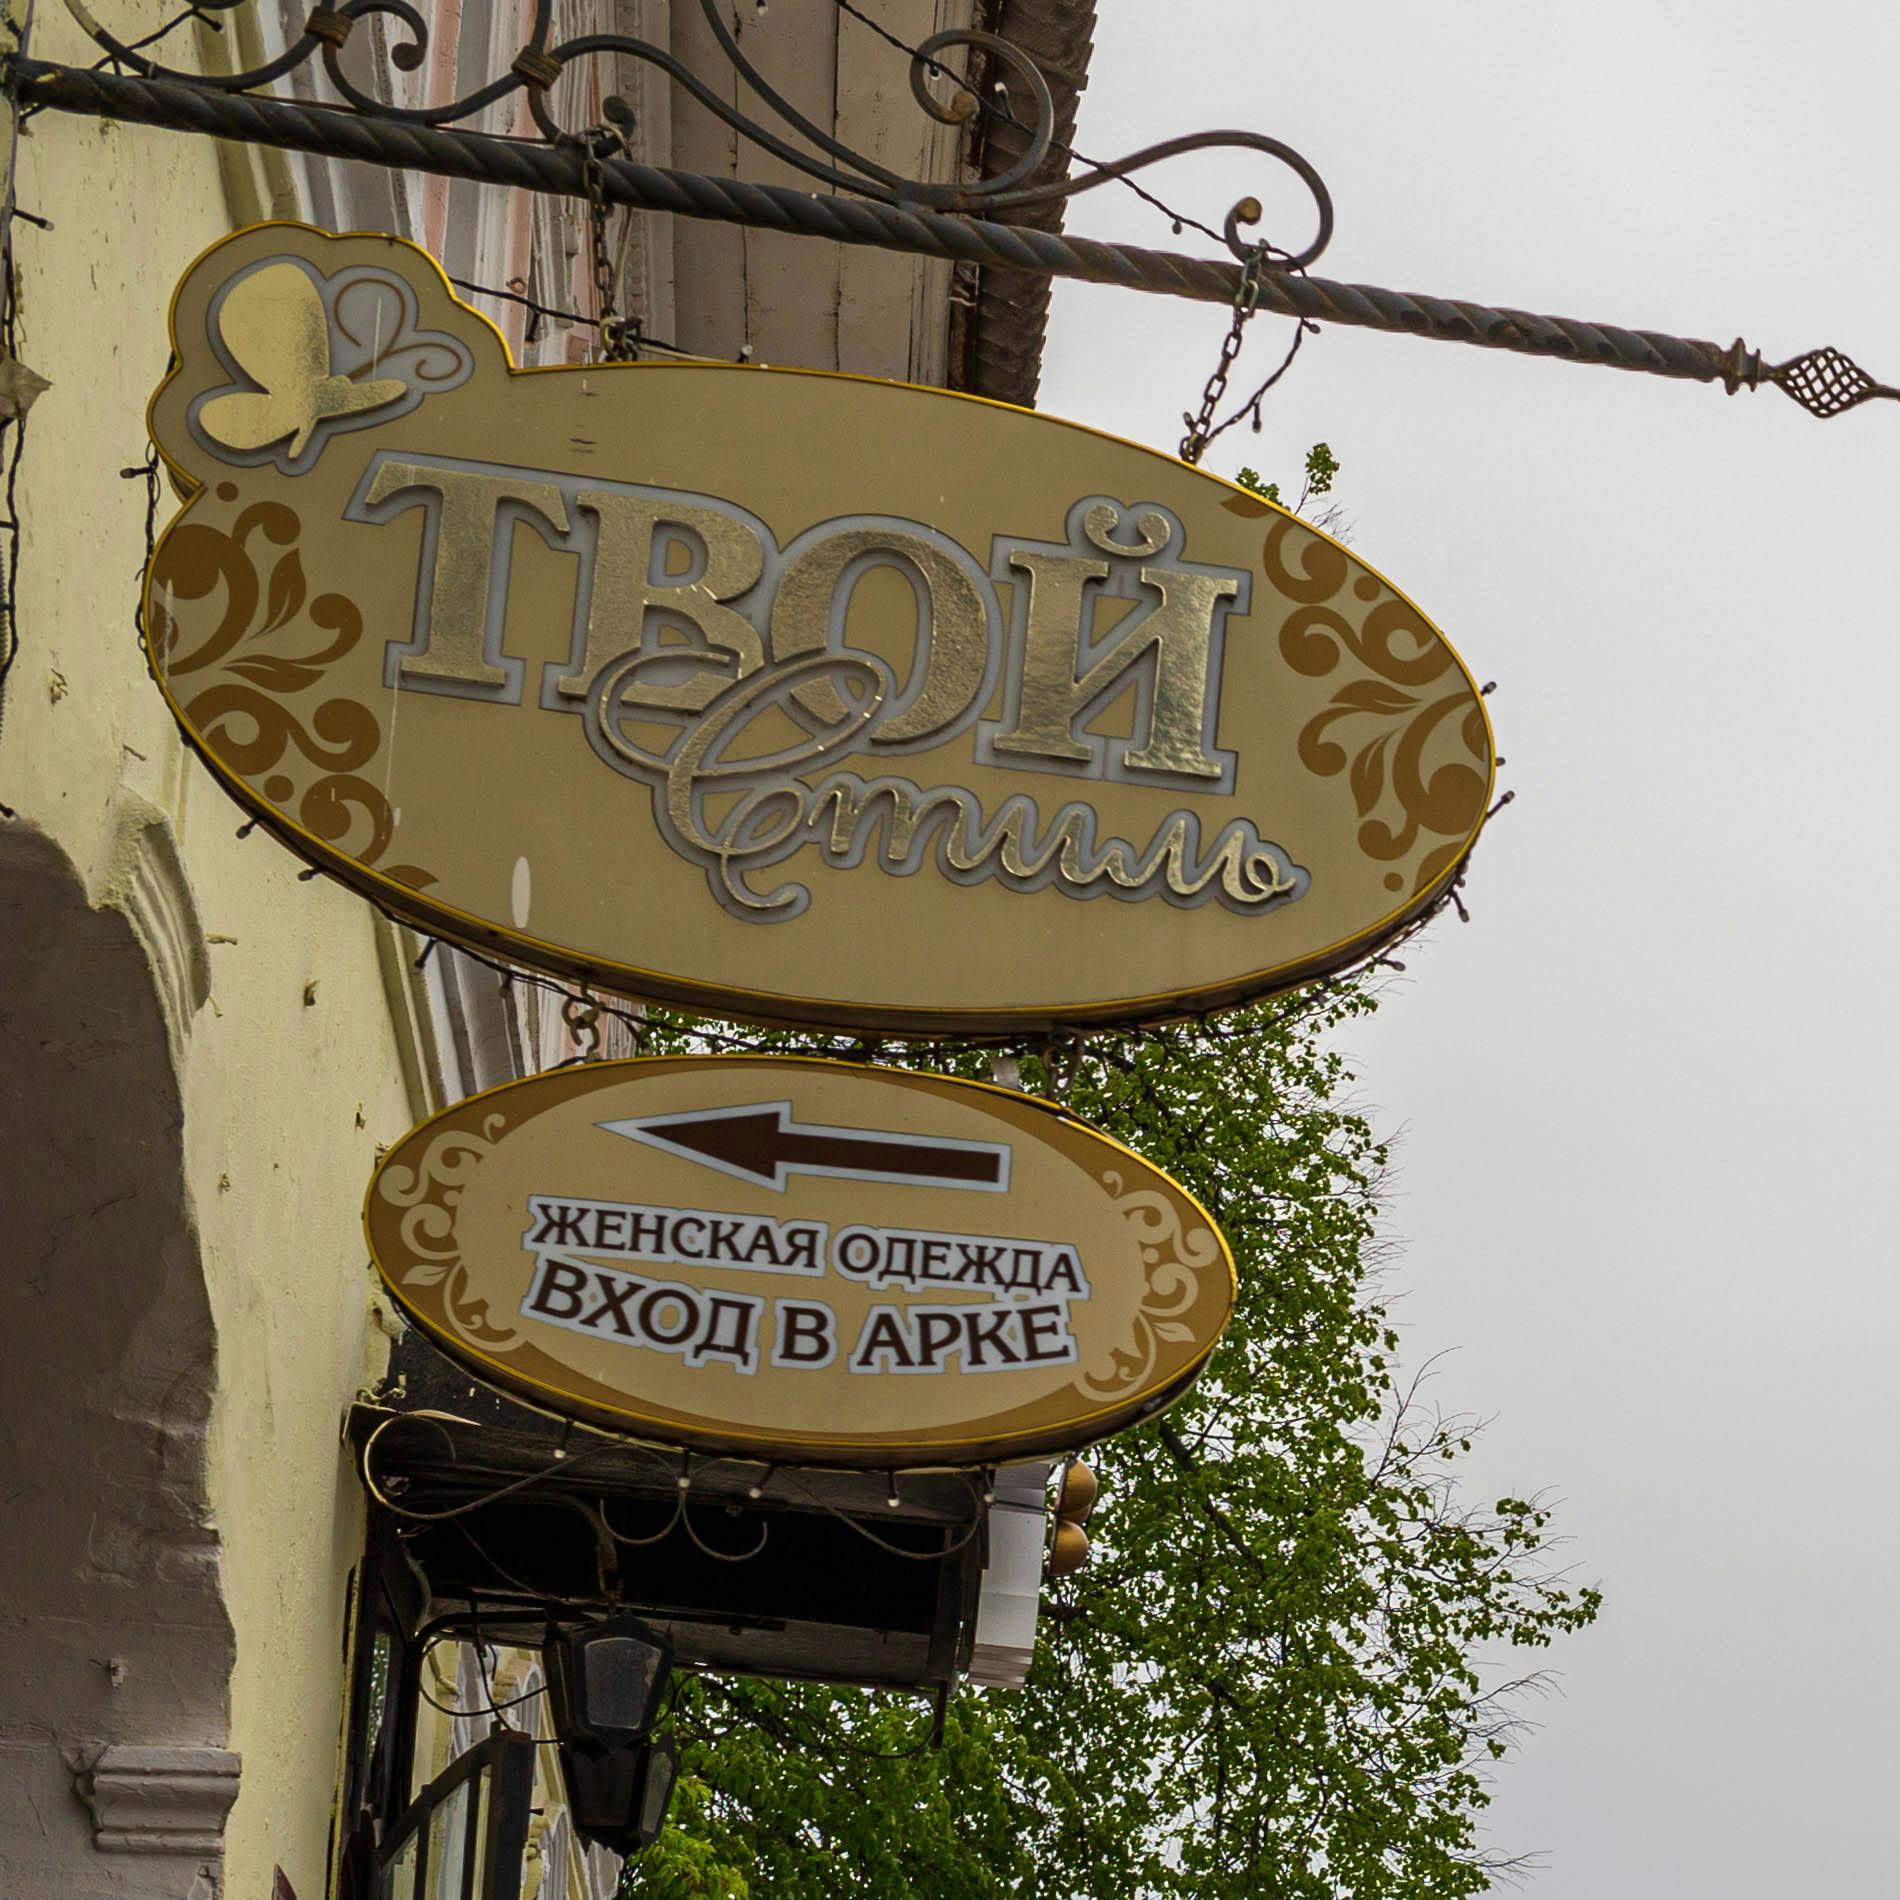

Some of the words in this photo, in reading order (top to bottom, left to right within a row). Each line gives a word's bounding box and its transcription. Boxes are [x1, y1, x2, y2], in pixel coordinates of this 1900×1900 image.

[362, 458, 1240, 780] ТВОЙ
[598, 645, 1299, 912] Стиль
[529, 1258, 756, 1367] ВХОД
[779, 1305, 831, 1363] В
[855, 1303, 1071, 1368] АРКЕ
[535, 1203, 821, 1270] ЖЕНСКАЯ
[837, 1231, 1082, 1294] ОДЕЖДА
